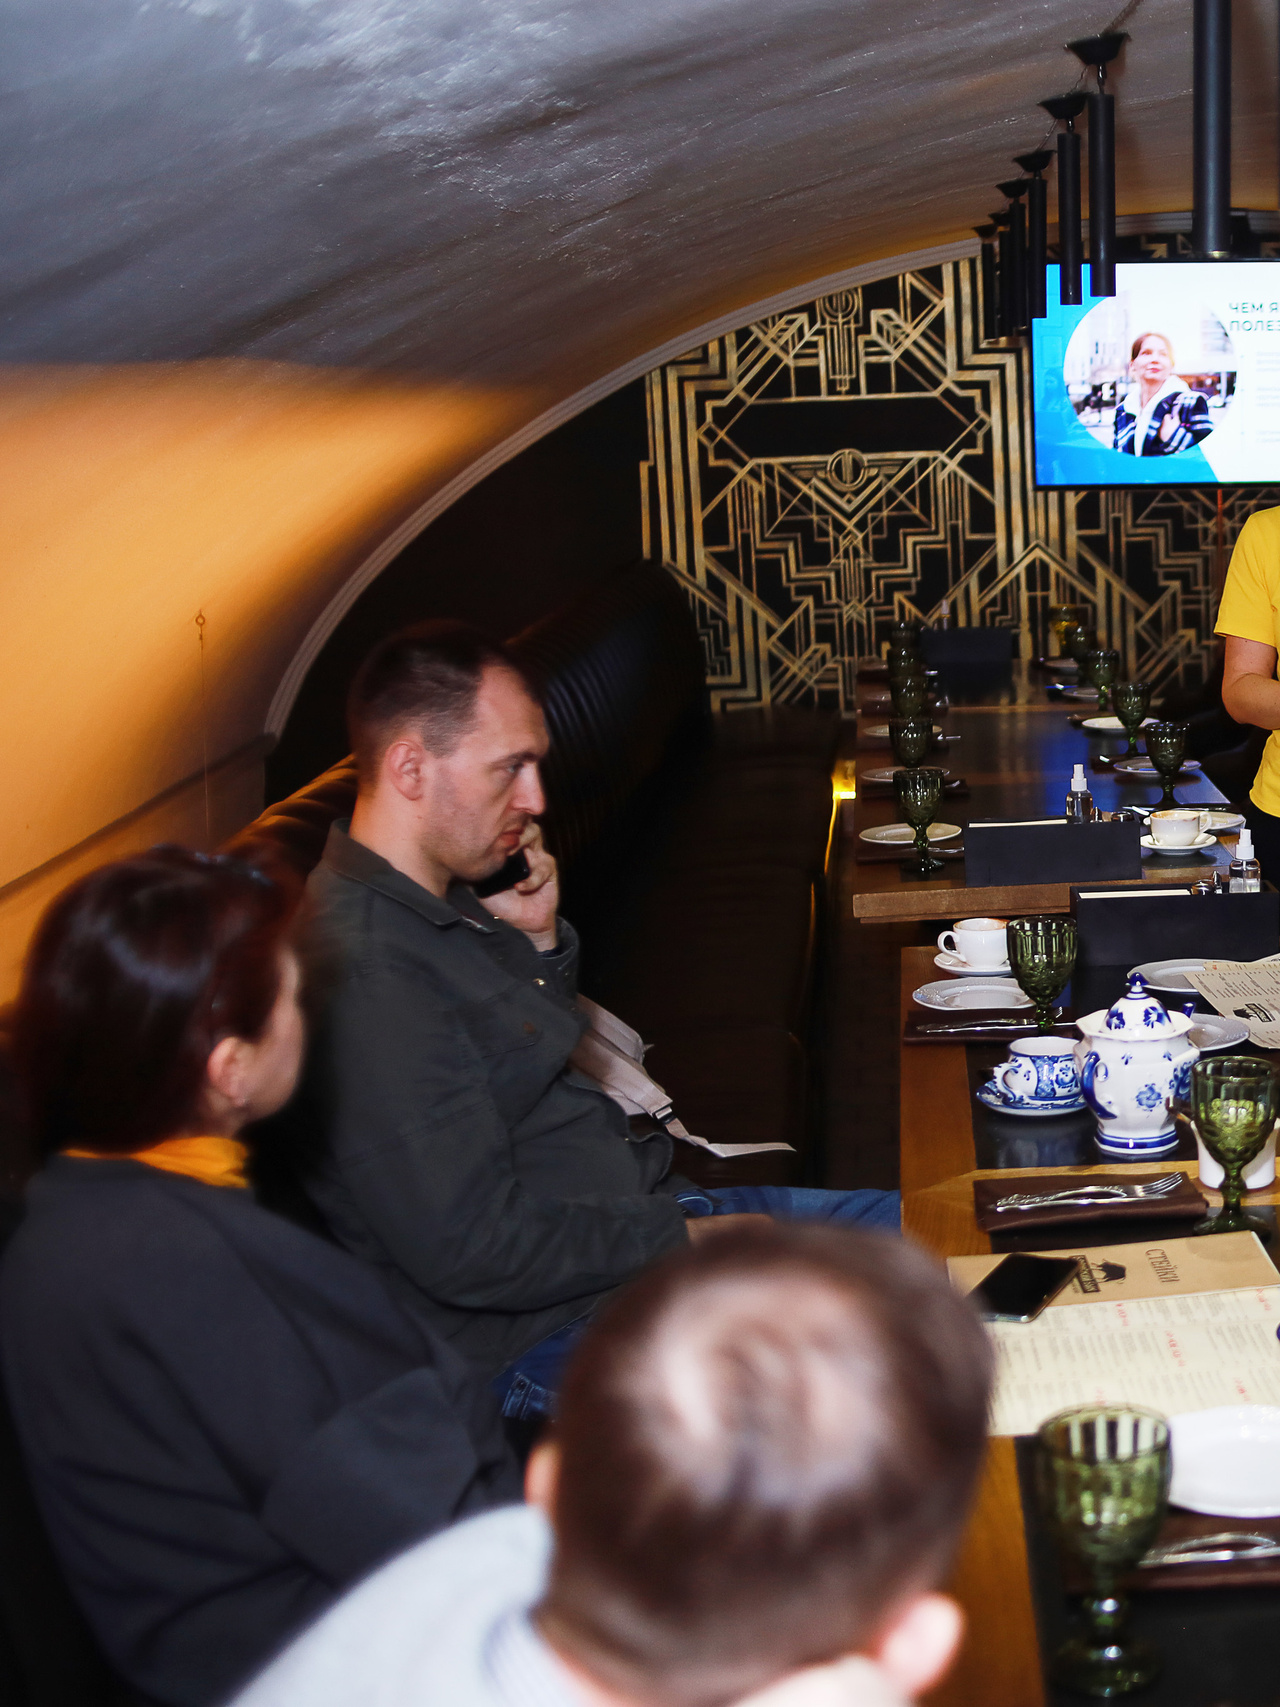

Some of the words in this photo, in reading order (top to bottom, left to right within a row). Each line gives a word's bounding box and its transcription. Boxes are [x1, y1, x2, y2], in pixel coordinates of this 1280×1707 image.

[1229, 302, 1264, 313] ЧЕМ
[1269, 302, 1278, 313] Я
[1145, 1248, 1181, 1283] СТЕЙКИ
